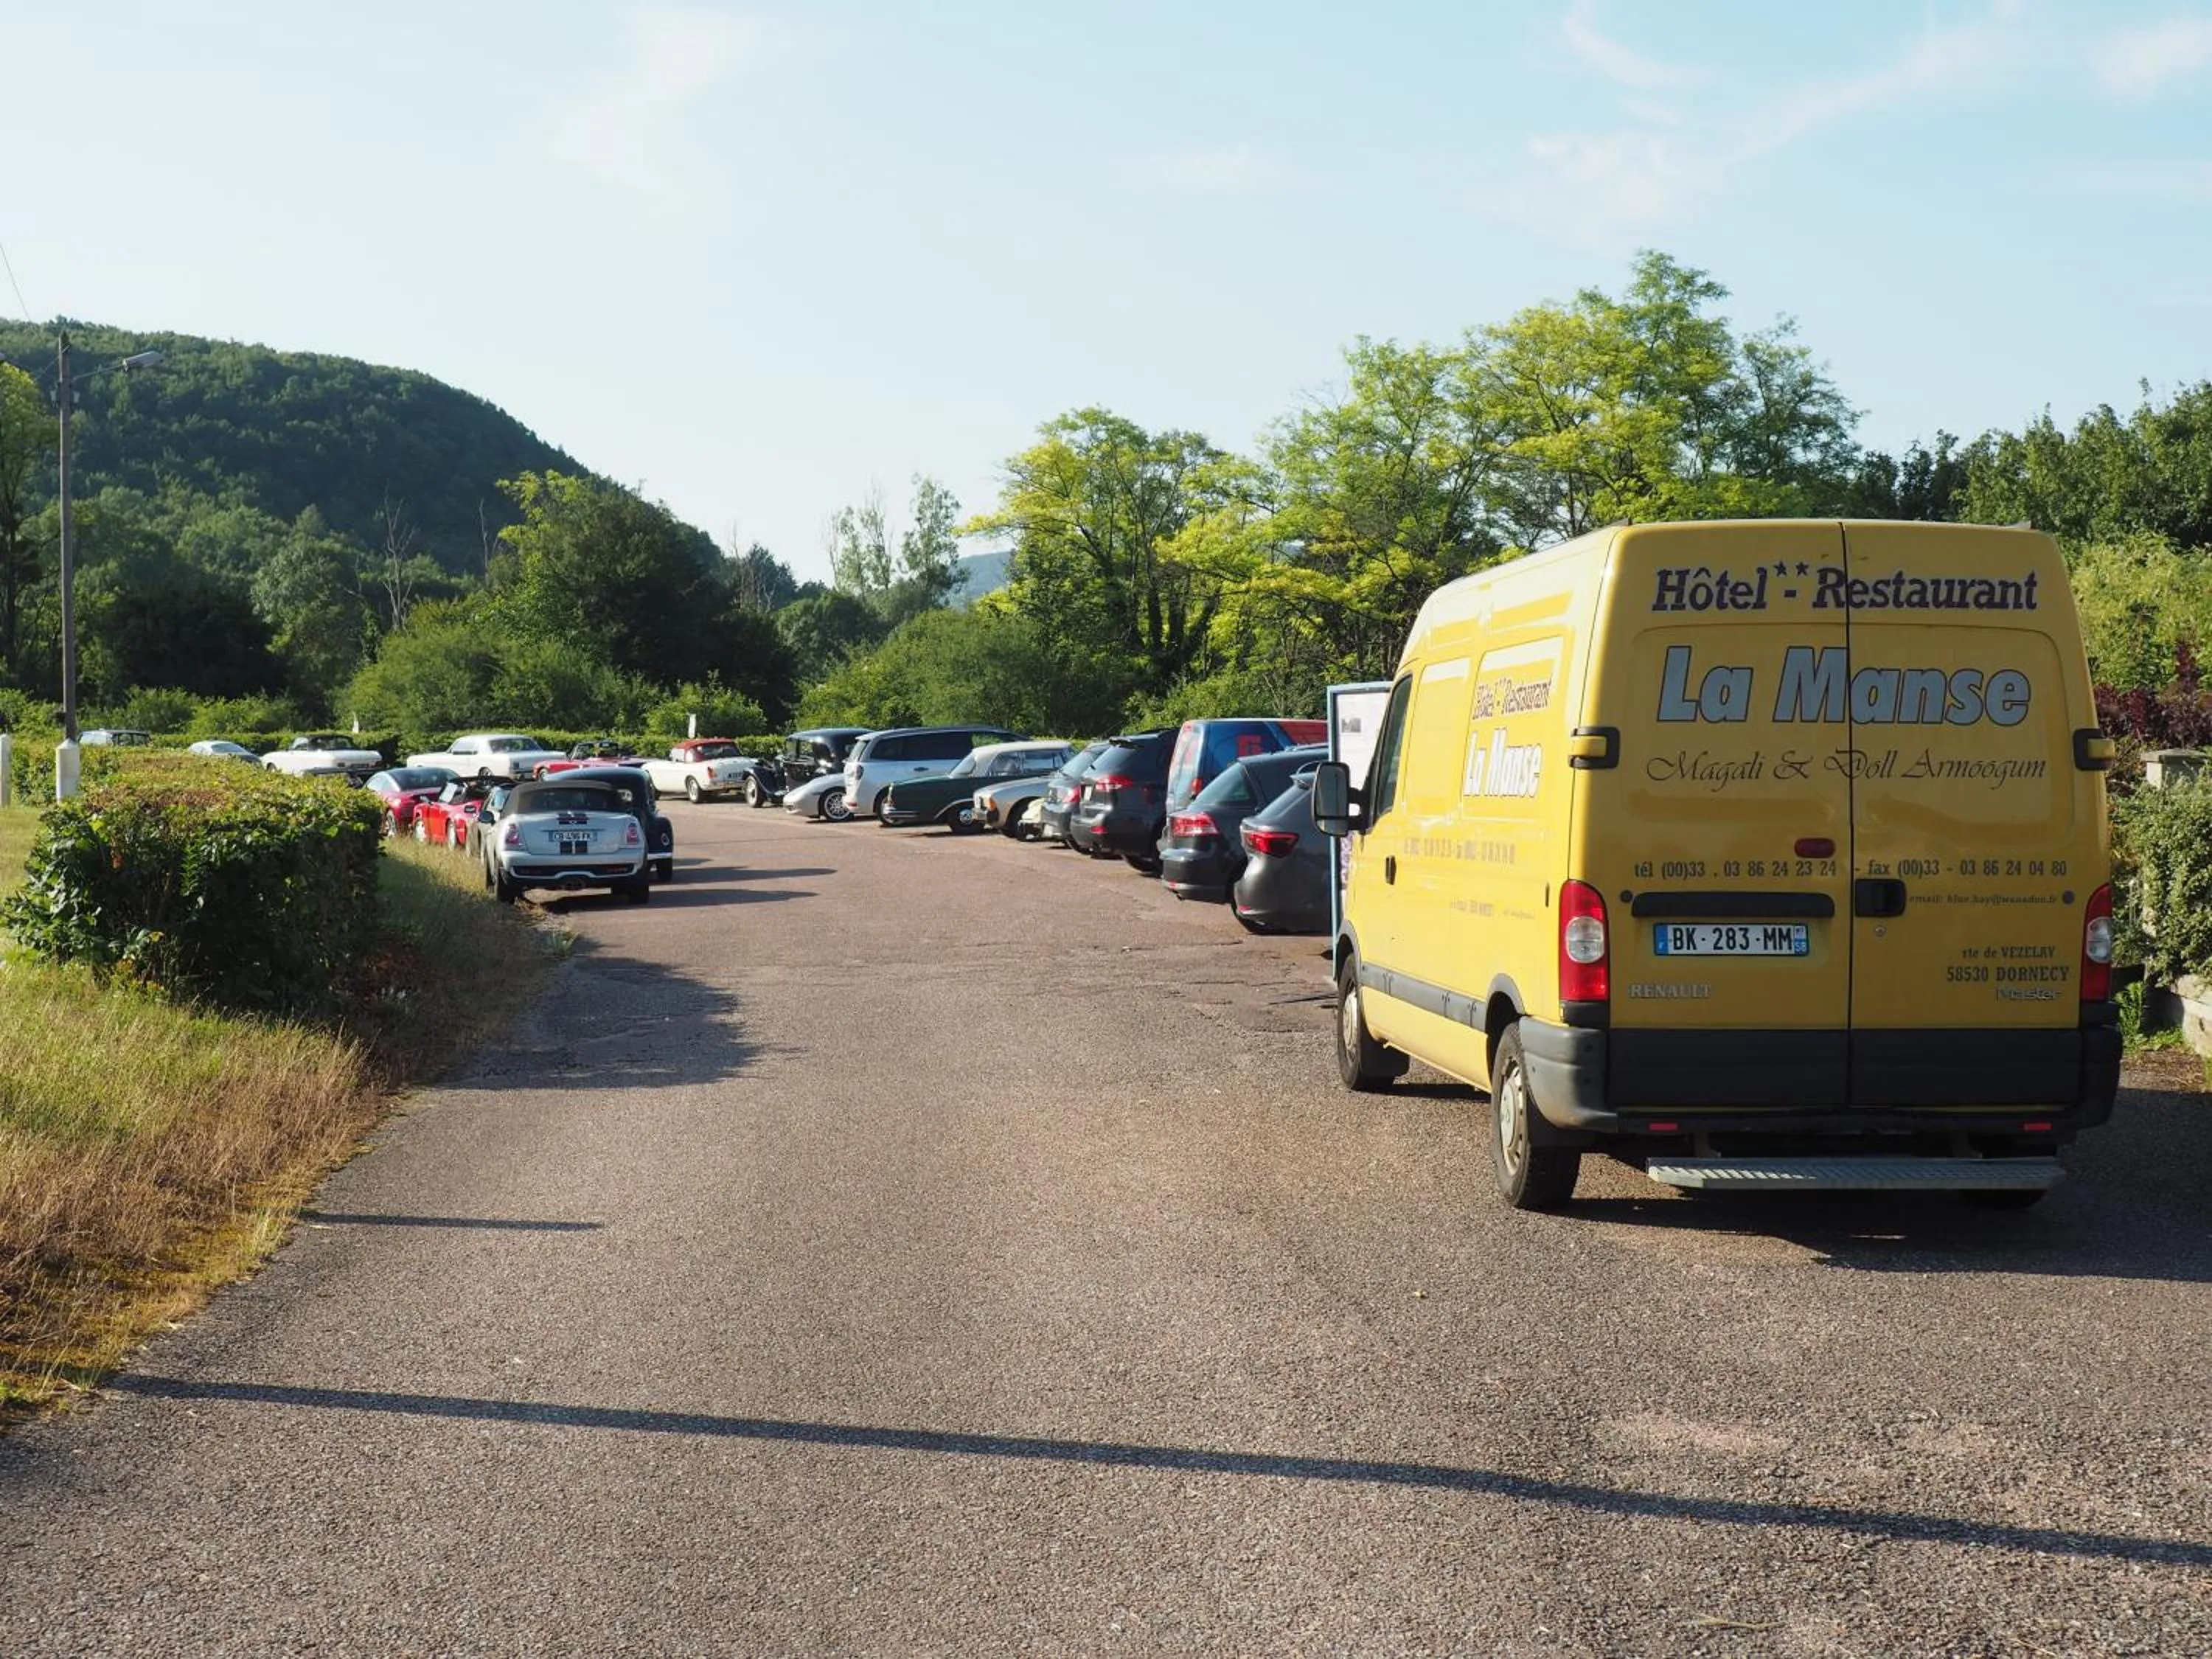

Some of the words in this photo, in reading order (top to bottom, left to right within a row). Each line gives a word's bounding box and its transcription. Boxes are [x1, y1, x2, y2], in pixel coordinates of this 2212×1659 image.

[1652, 568, 1767, 611] Hôtel
[1812, 566, 2037, 610] Restaurant
[1657, 646, 1753, 723] La
[1772, 646, 2031, 726] Manse
[1646, 750, 1765, 793] Magali
[1635, 861, 1653, 877] tél
[1661, 860, 1705, 880] (00)33
[1724, 861, 1740, 877] 03
[1748, 861, 1764, 877] 86
[1772, 860, 1789, 877] 24
[1795, 860, 1812, 877] 23
[1820, 860, 1837, 877] 24
[1868, 859, 1890, 874] fax
[1897, 858, 1940, 878] (00)33
[1960, 859, 1976, 875] 03
[1983, 860, 1999, 876] 86
[2006, 860, 2022, 876] 24
[2029, 860, 2045, 876] 04
[2051, 861, 2067, 876] 80
[1984, 947, 1998, 958] de
[1946, 966, 1989, 982] 58530
[1995, 966, 2070, 981] DORNECY
[1630, 984, 1711, 999] RENAULT
